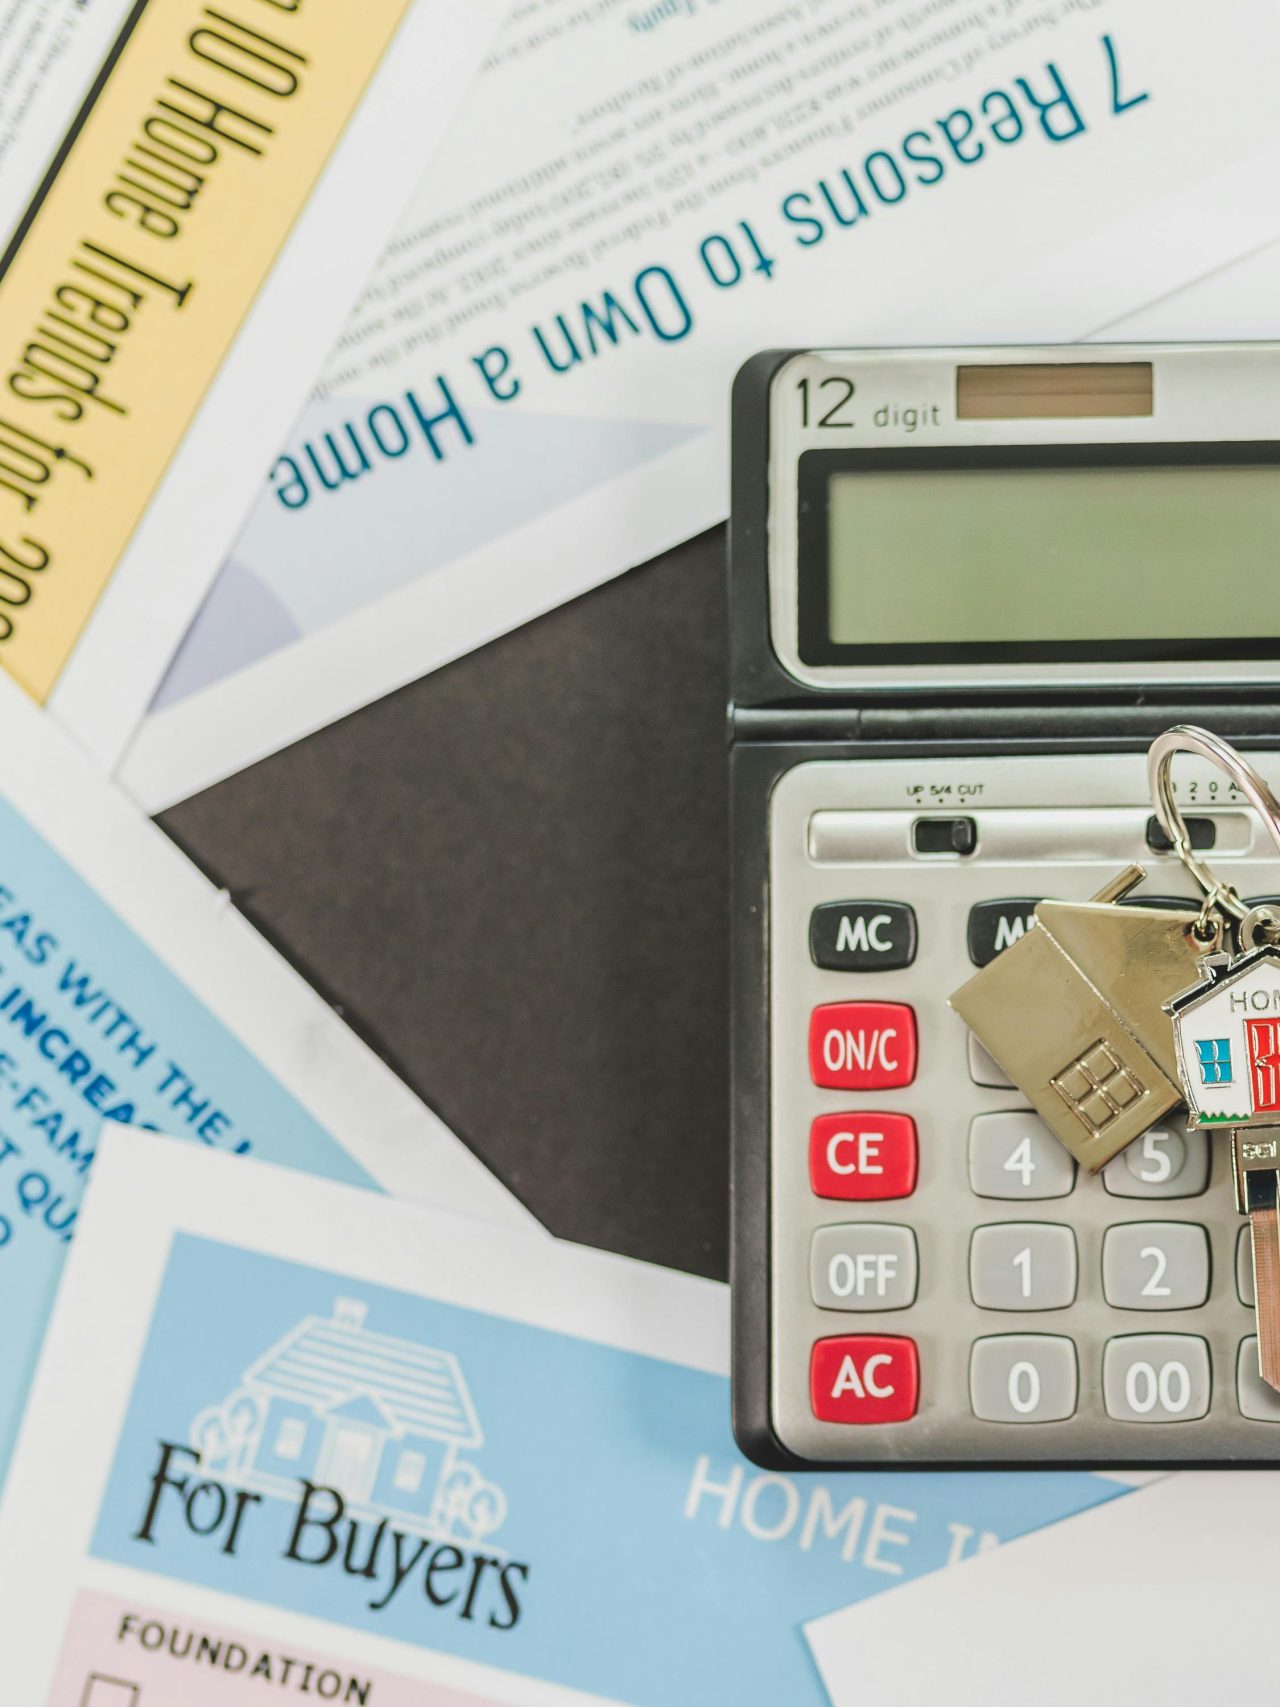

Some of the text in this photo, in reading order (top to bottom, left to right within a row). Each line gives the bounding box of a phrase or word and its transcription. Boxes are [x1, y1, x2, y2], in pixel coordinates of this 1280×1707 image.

[188, 8, 308, 98] 10
[103, 77, 275, 240] Home
[267, 33, 1151, 512] 7 Reasons to Own a Home
[8, 240, 194, 422] Trends
[795, 375, 942, 433] 12 digit
[906, 785, 924, 796] UP
[958, 784, 985, 796] CUT
[835, 914, 893, 952] MC
[993, 915, 1040, 951] M
[58, 958, 157, 1069] WITH
[154, 1056, 234, 1148] THE
[822, 1029, 898, 1071] ON/C
[825, 1132, 884, 1176] CE
[1002, 1137, 1036, 1187] 4
[1139, 1132, 1173, 1184] 5
[827, 1253, 898, 1297] OFF
[1012, 1246, 1033, 1298] 1
[1139, 1246, 1172, 1297] 2
[830, 1353, 895, 1399] AC
[1007, 1361, 1041, 1414] 0
[1124, 1361, 1191, 1414] 00
[130, 1436, 531, 1632] For Buyers
[683, 1453, 918, 1577] HOME
[116, 1613, 374, 1706] FOUNDATION
